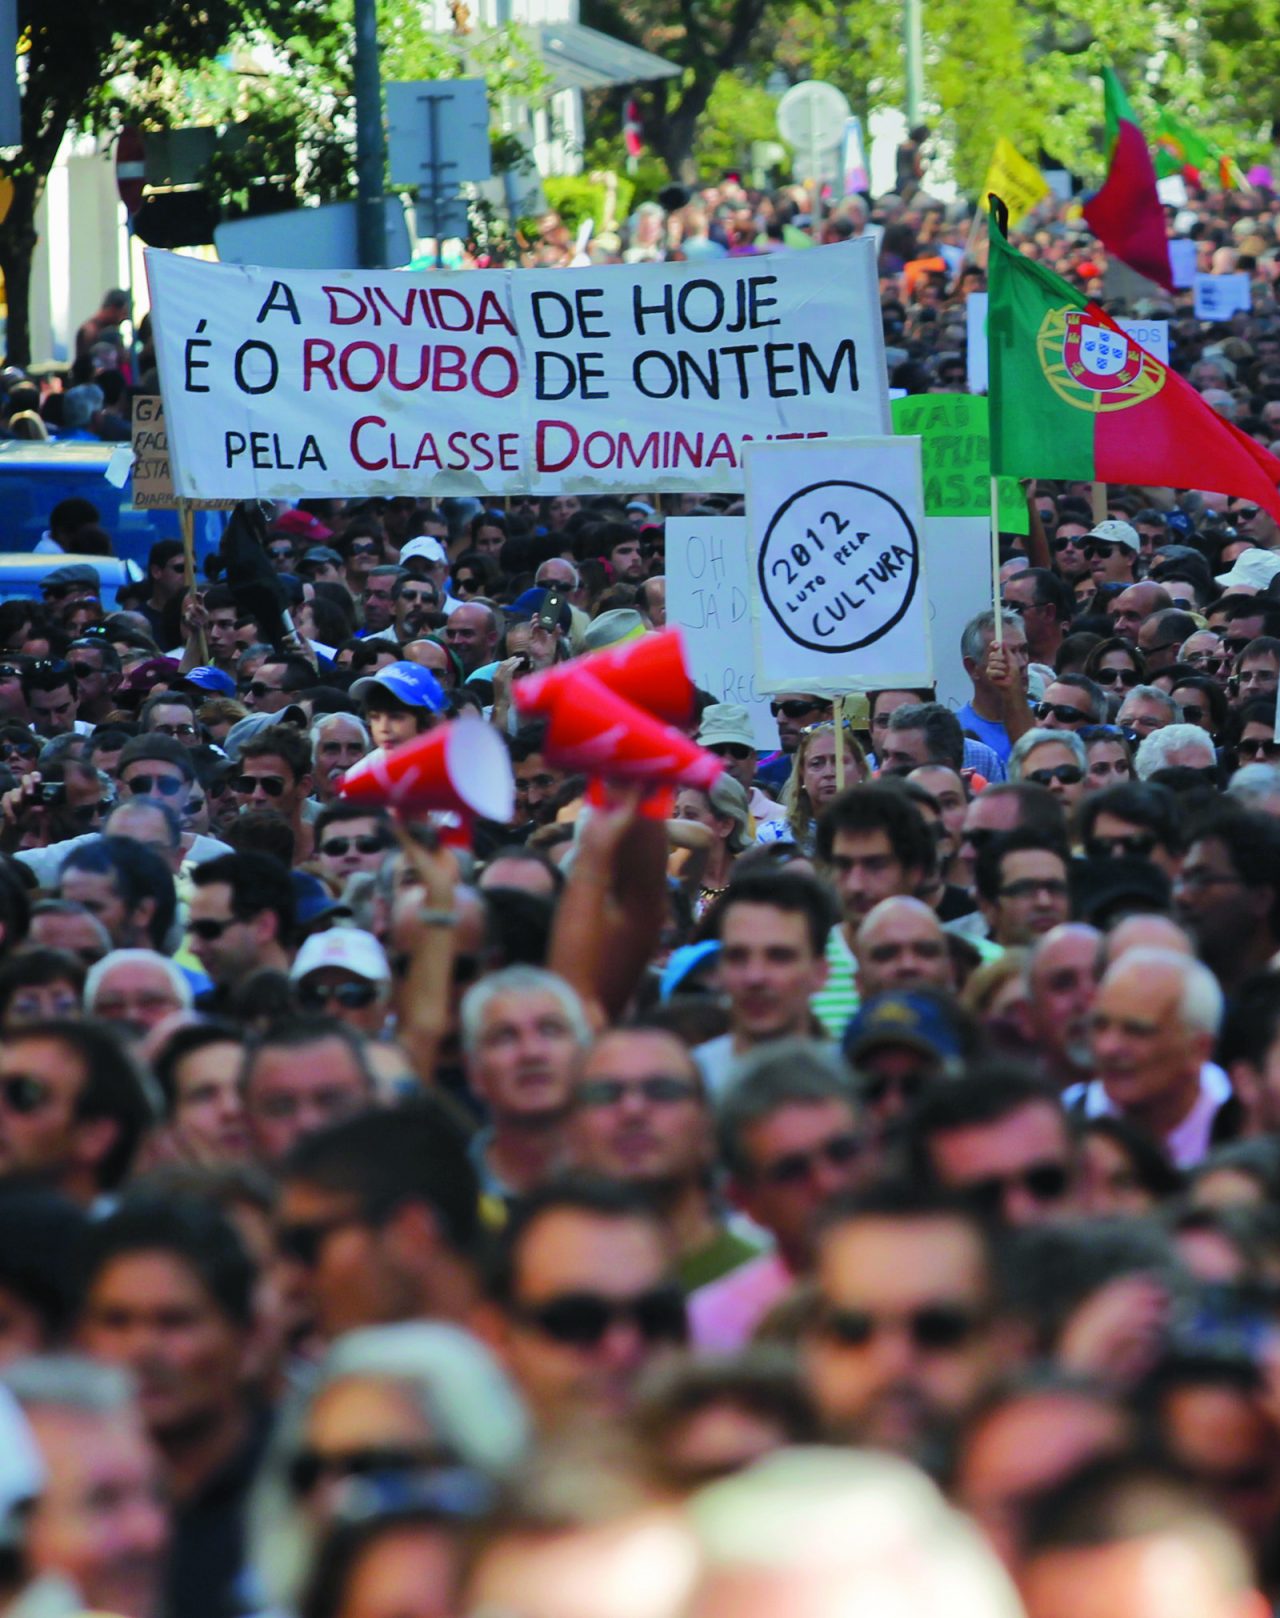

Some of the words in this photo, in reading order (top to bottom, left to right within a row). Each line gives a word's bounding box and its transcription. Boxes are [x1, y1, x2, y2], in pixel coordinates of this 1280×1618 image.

[256, 281, 302, 326] A
[322, 285, 519, 337] DIVIDA
[531, 288, 611, 339] DE
[633, 275, 781, 335] HOJE
[184, 319, 212, 393] É
[234, 338, 279, 395] O
[303, 337, 519, 399] ROUBO
[535, 350, 609, 400] DE
[632, 338, 859, 399] ONTEM
[224, 430, 328, 471] PELA
[350, 415, 519, 472] CLASSE
[536, 419, 828, 474] DOMINA
[772, 511, 850, 584] 2012
[786, 575, 827, 613] LUTO
[834, 531, 871, 565] PELA
[812, 544, 914, 637] CULTURA
